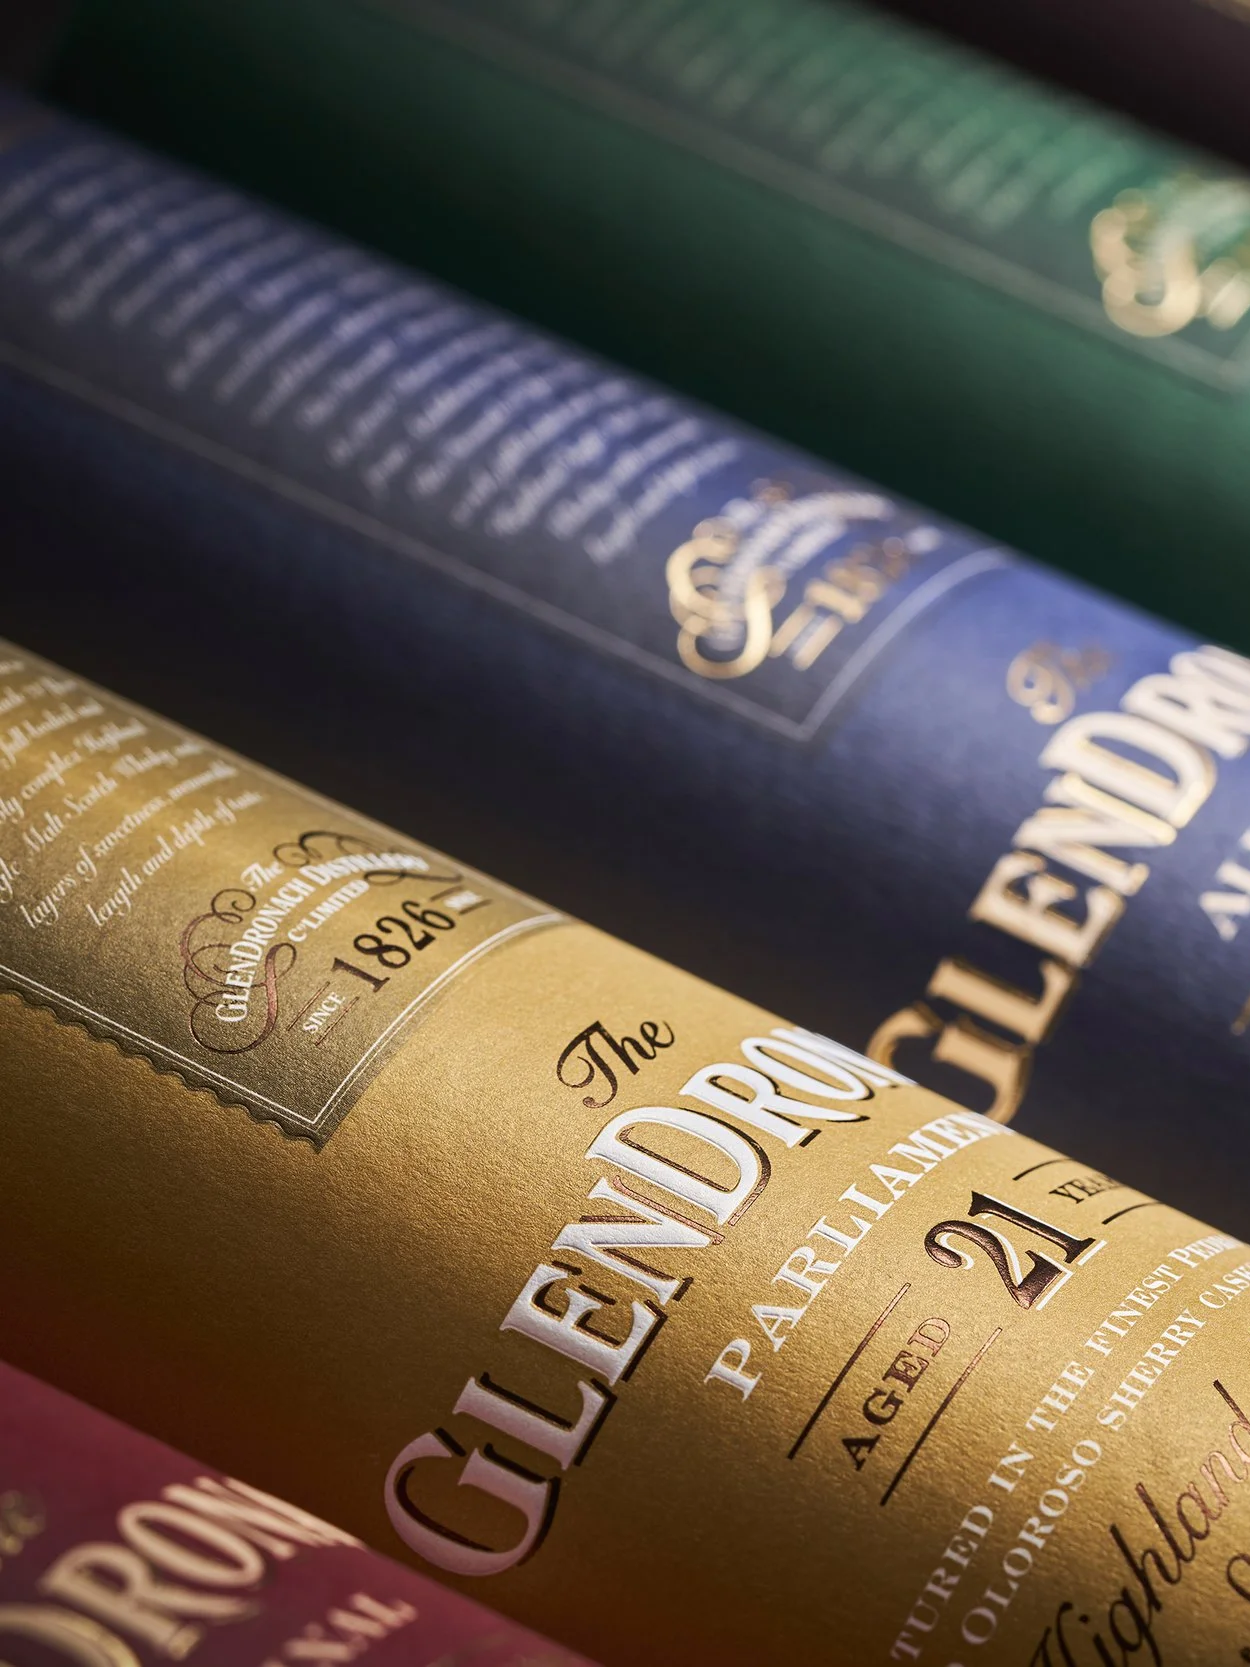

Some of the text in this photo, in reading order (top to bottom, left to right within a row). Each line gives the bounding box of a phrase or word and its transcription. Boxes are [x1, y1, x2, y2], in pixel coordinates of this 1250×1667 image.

[20, 873, 77, 929] layers
[76, 842, 98, 882] of
[86, 867, 142, 927] length
[142, 835, 175, 876] and
[173, 808, 217, 848] depth
[240, 860, 285, 892] The
[303, 879, 370, 931] LIMITED
[214, 877, 316, 1023] GLENDRONACH
[302, 900, 456, 1035] SINCE 1826
[556, 1017, 676, 1109] The
[704, 1111, 1015, 1401] PARLIAMEN
[840, 1315, 952, 1471] AGED
[925, 1190, 1107, 1311] 21
[988, 1441, 1035, 1493] IN
[1025, 1360, 1095, 1432] THE
[1085, 1263, 1184, 1357] FINEST
[961, 1439, 1102, 1645] OLOROSO
[1096, 1307, 1207, 1432] SHERRY
